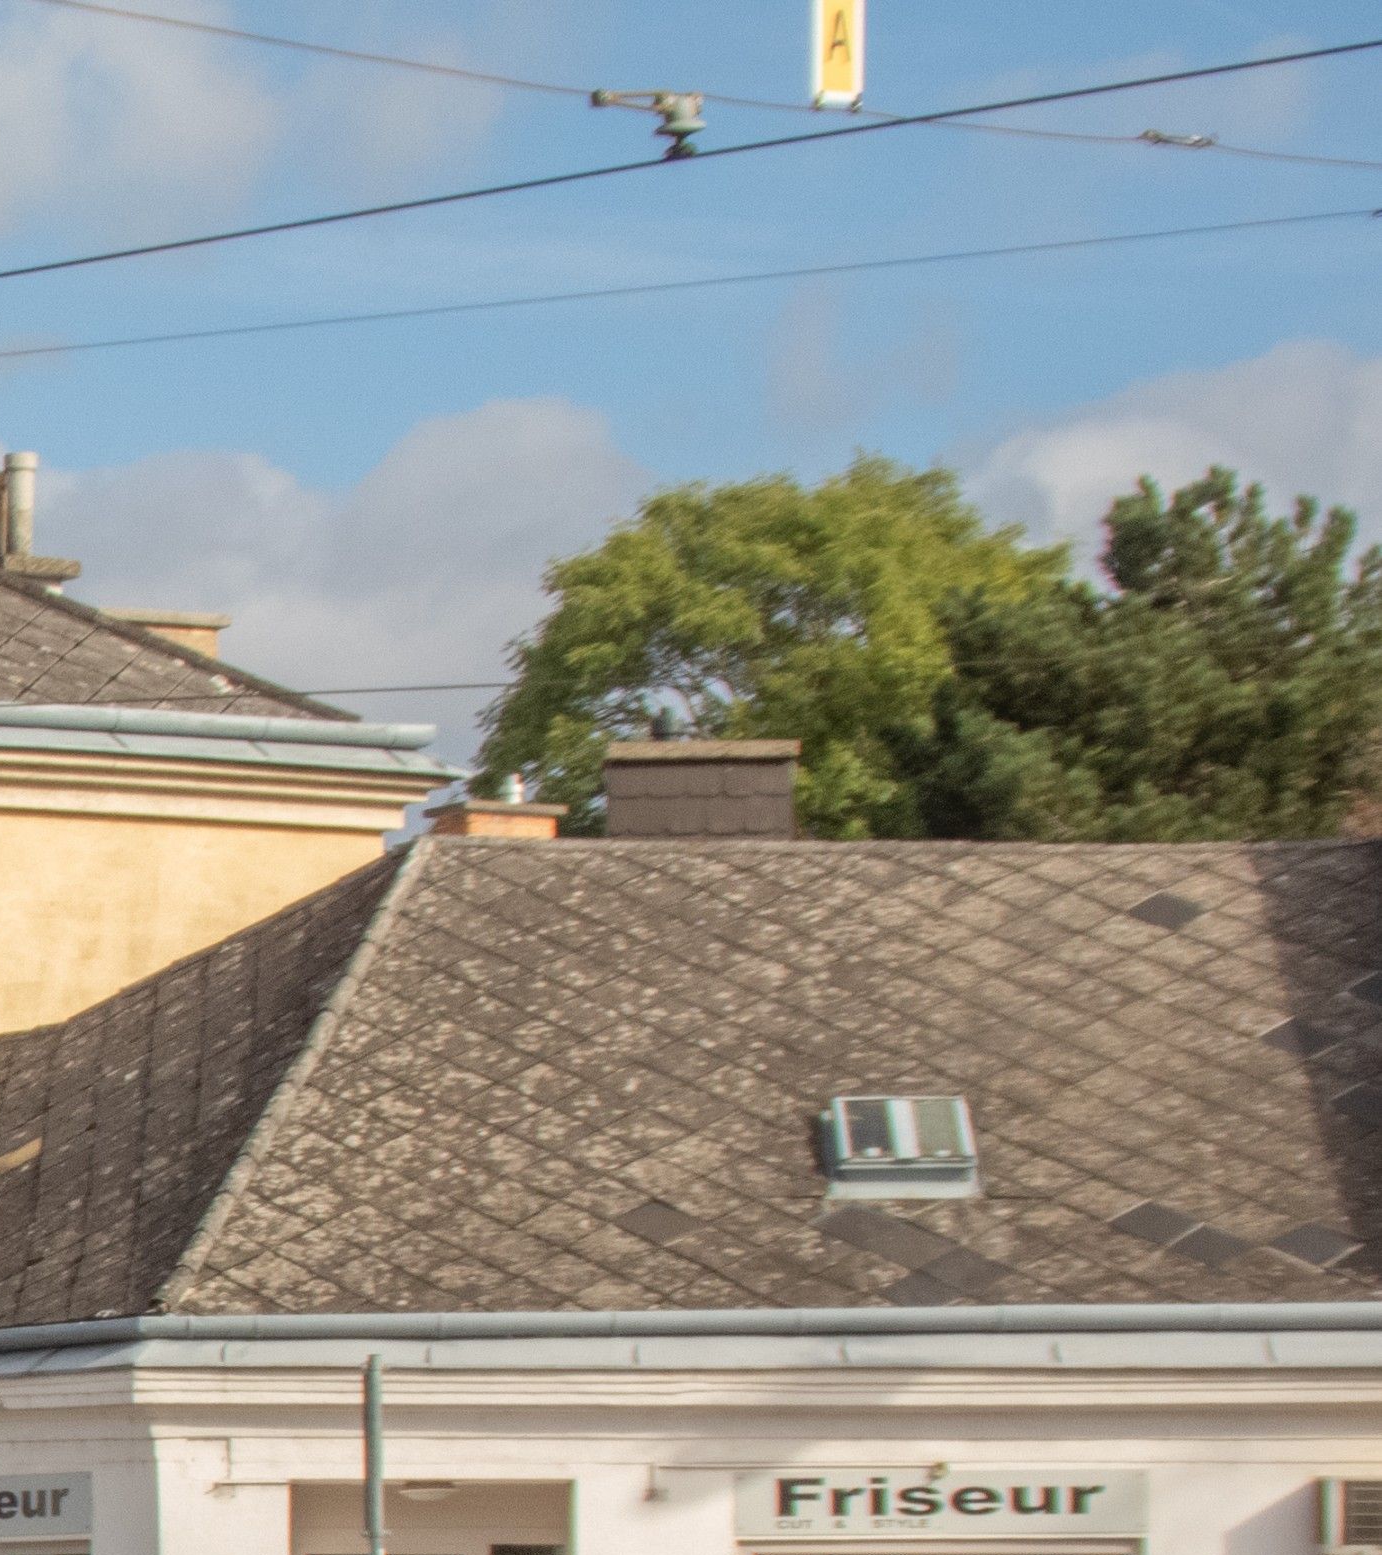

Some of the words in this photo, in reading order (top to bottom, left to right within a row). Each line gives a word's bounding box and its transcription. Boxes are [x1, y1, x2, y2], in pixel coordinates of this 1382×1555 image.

[825, 9, 851, 63] A
[775, 1477, 1105, 1517] Friseur
[776, 1519, 812, 1529] CUT
